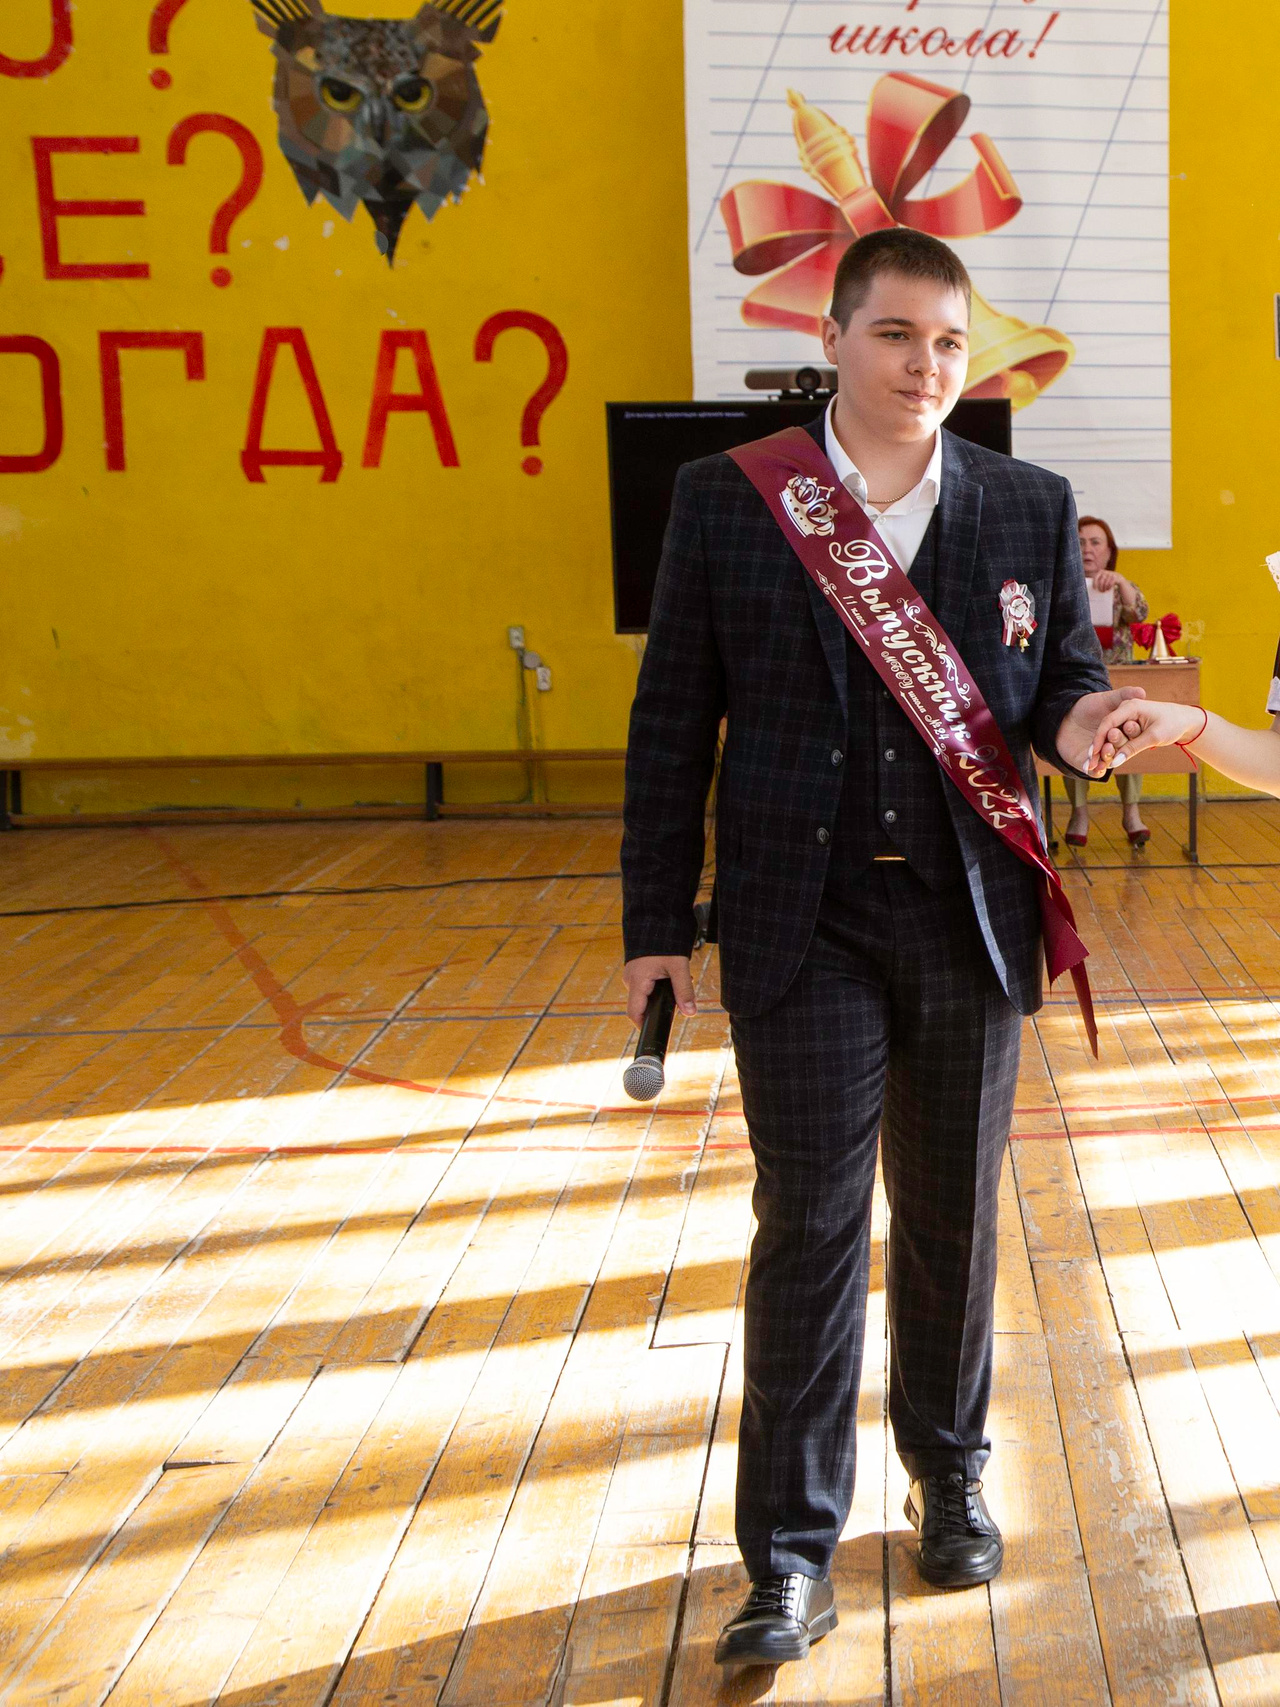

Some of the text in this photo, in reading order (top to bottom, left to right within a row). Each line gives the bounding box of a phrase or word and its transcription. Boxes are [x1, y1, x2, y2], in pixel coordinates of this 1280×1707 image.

[829, 11, 1060, 59] школа!
[0, 112, 264, 288] Е?
[829, 539, 971, 743] Выпускник
[842, 595, 858, 605] 11
[881, 650, 950, 741] МБОУ школа №24
